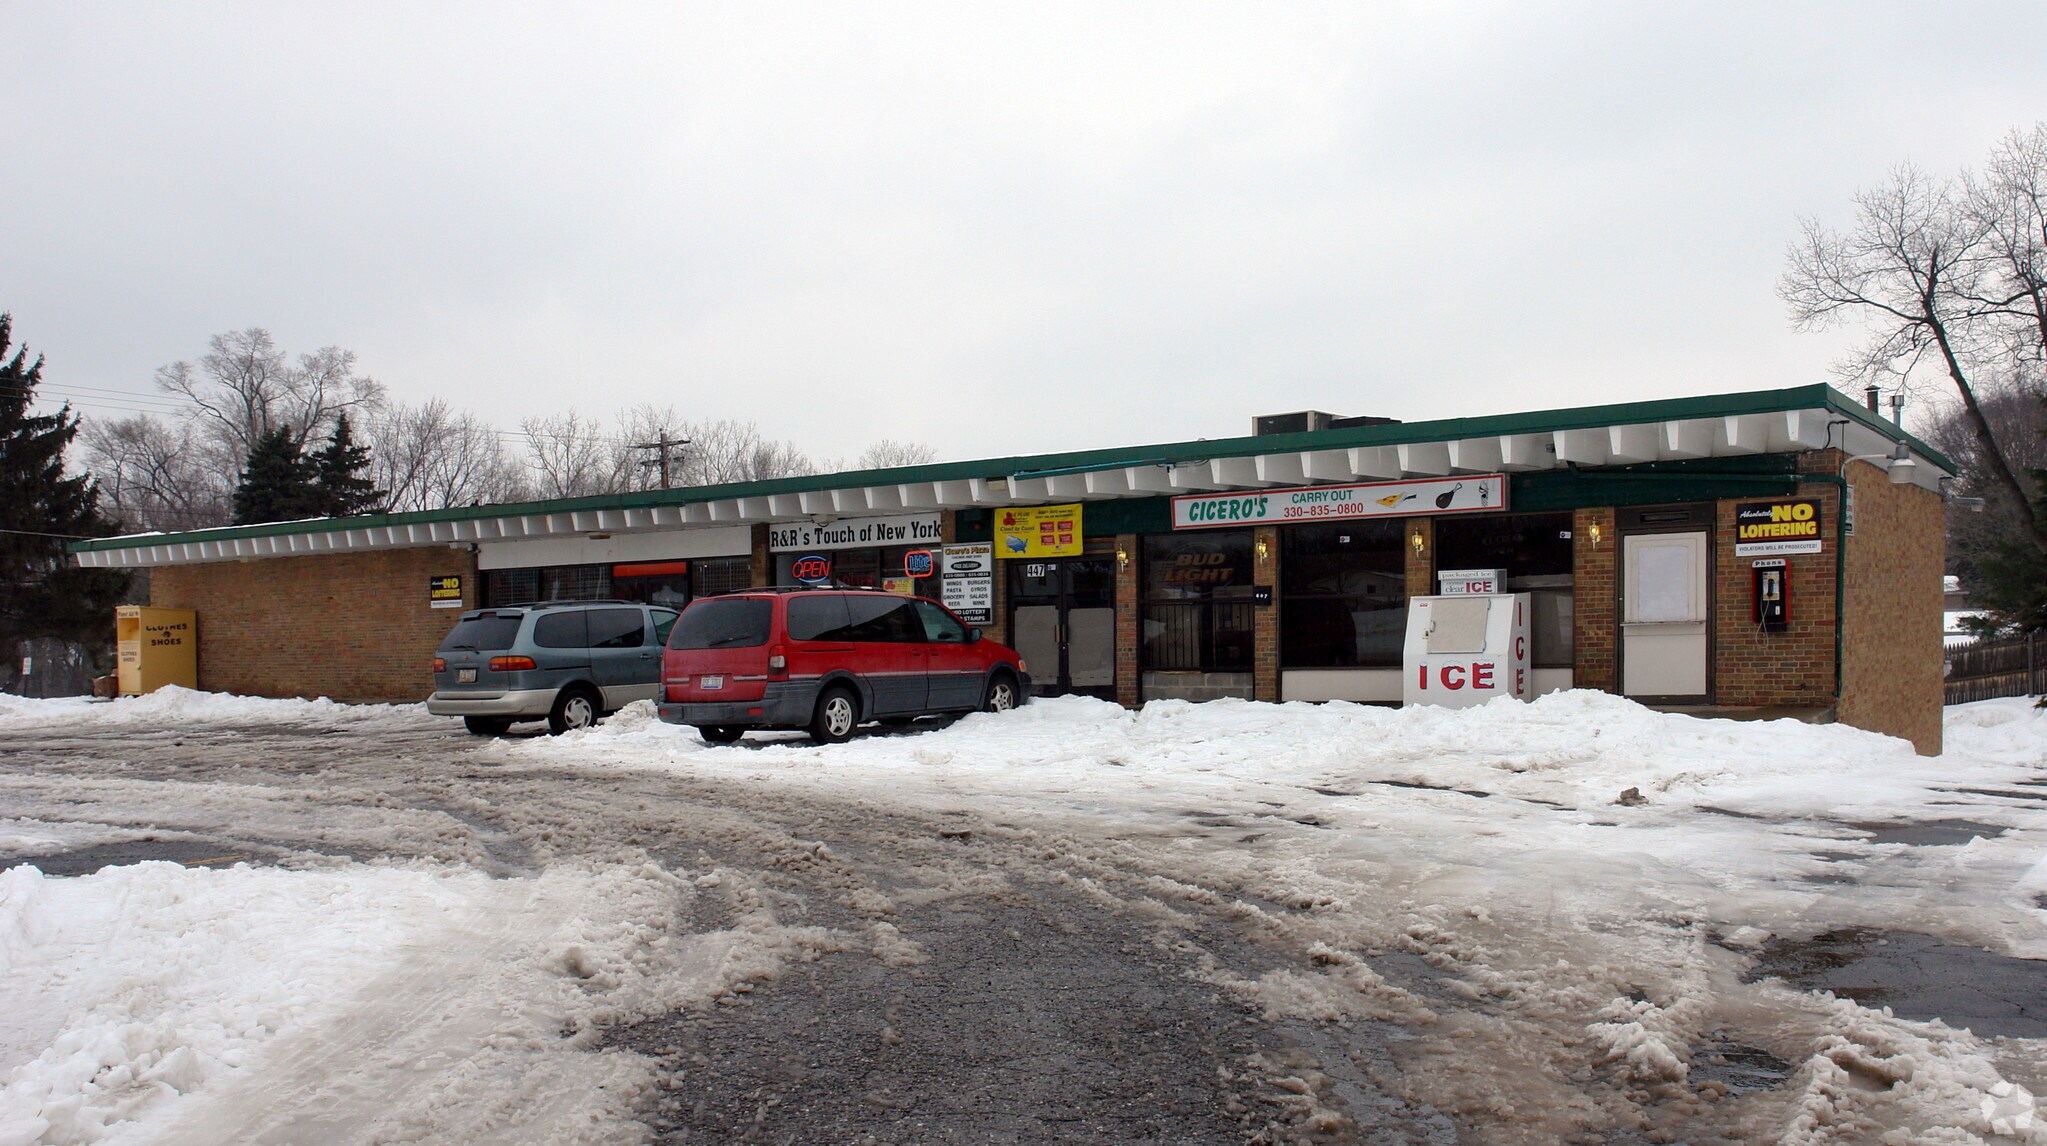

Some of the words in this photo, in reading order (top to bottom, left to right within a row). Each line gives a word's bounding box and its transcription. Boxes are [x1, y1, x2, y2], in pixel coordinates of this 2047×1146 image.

[1291, 491, 1329, 504] CARRY
[1330, 490, 1353, 501] OUT
[1189, 497, 1268, 521] CICERO'S
[1284, 503, 1364, 518] 330-835-0800
[1740, 510, 1774, 519] Absolutely
[1771, 503, 1814, 522] NO
[771, 527, 810, 547] R&R's
[814, 526, 855, 545] Touch
[860, 524, 872, 542] of
[877, 523, 906, 541] New
[911, 520, 941, 539] York
[1740, 521, 1817, 539] LOITERING
[1175, 553, 1226, 566] BUD
[791, 561, 831, 579] OPEN
[1028, 565, 1044, 576] 447
[1164, 568, 1235, 582] LIGHT
[1442, 571, 1479, 579] packaged
[443, 577, 459, 588] NO
[1445, 585, 1465, 593] clear
[1465, 581, 1493, 593] ICE
[151, 639, 182, 647] SHOES
[1516, 602, 1524, 695] ICE
[1419, 660, 1495, 690] ICE
